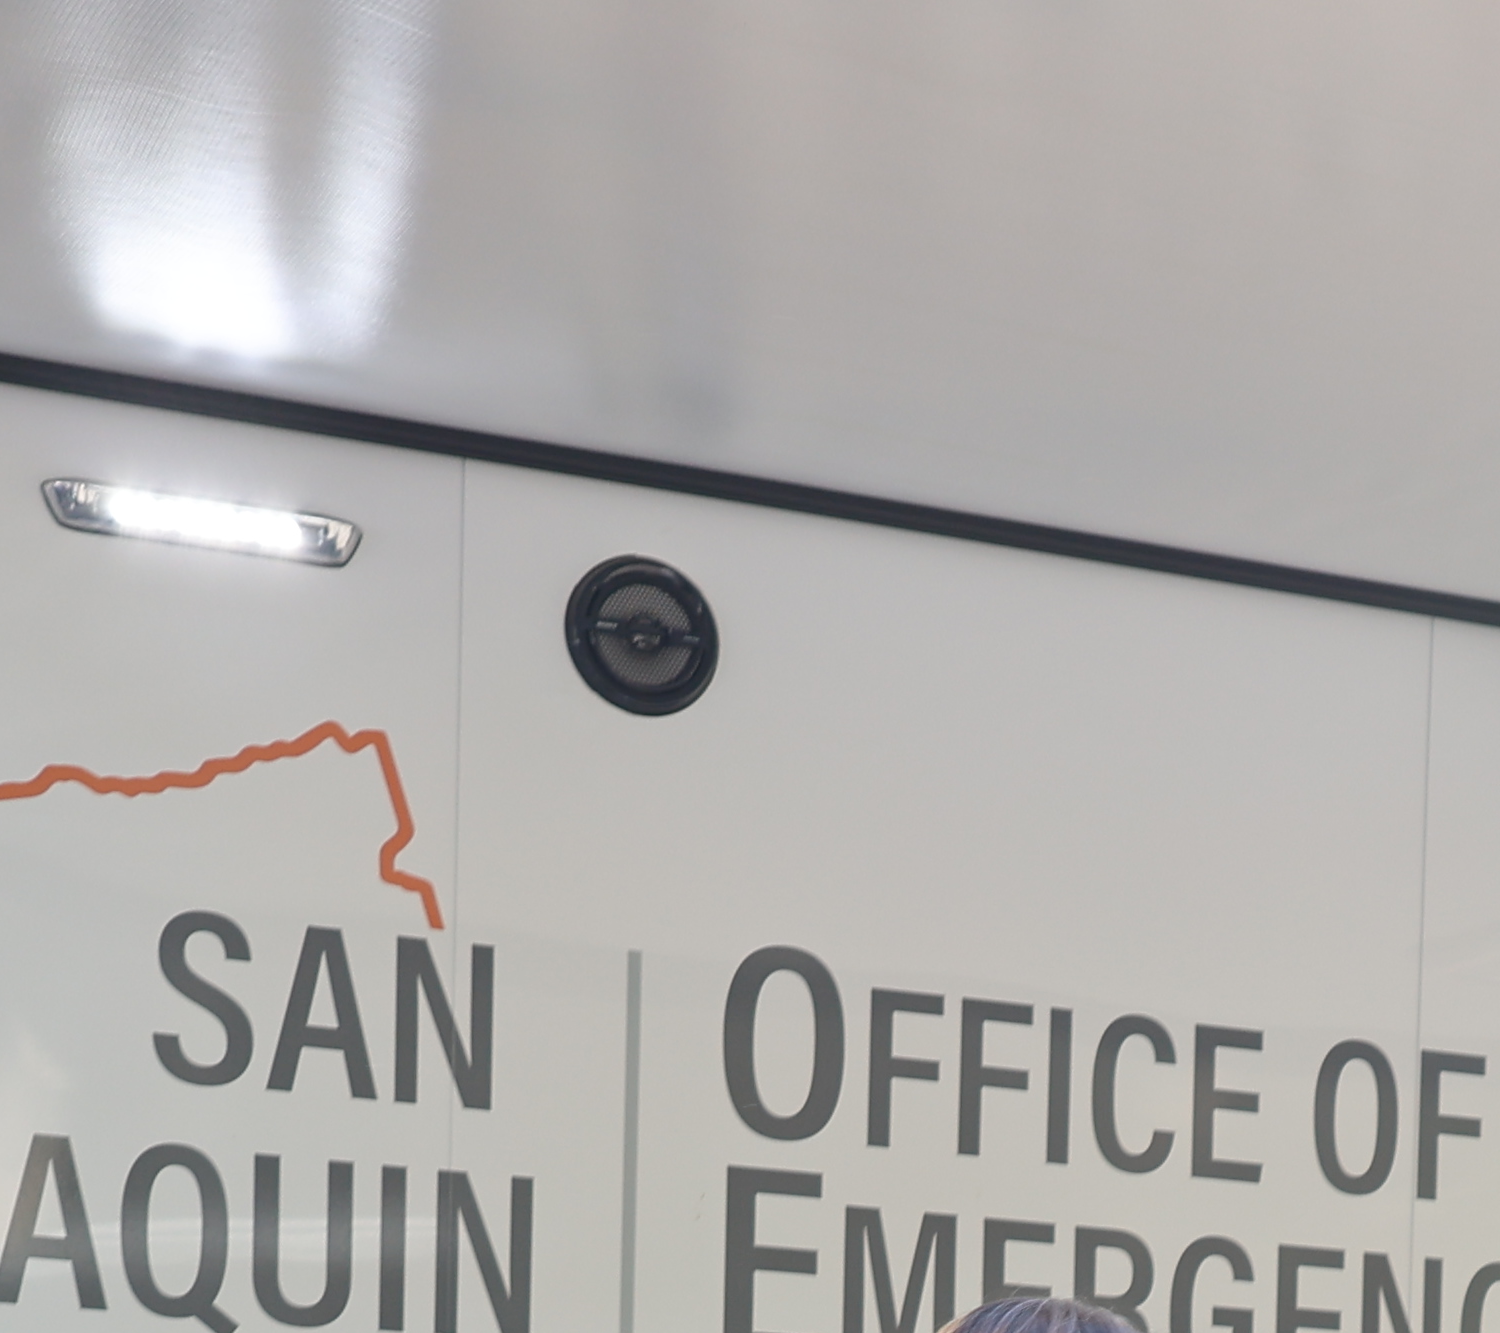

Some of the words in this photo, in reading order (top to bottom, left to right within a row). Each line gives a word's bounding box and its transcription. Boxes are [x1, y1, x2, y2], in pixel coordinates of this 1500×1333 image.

[153, 910, 495, 1110] SAN
[722, 945, 1265, 1184] OFFICE
[1313, 1038, 1487, 1200] OF
